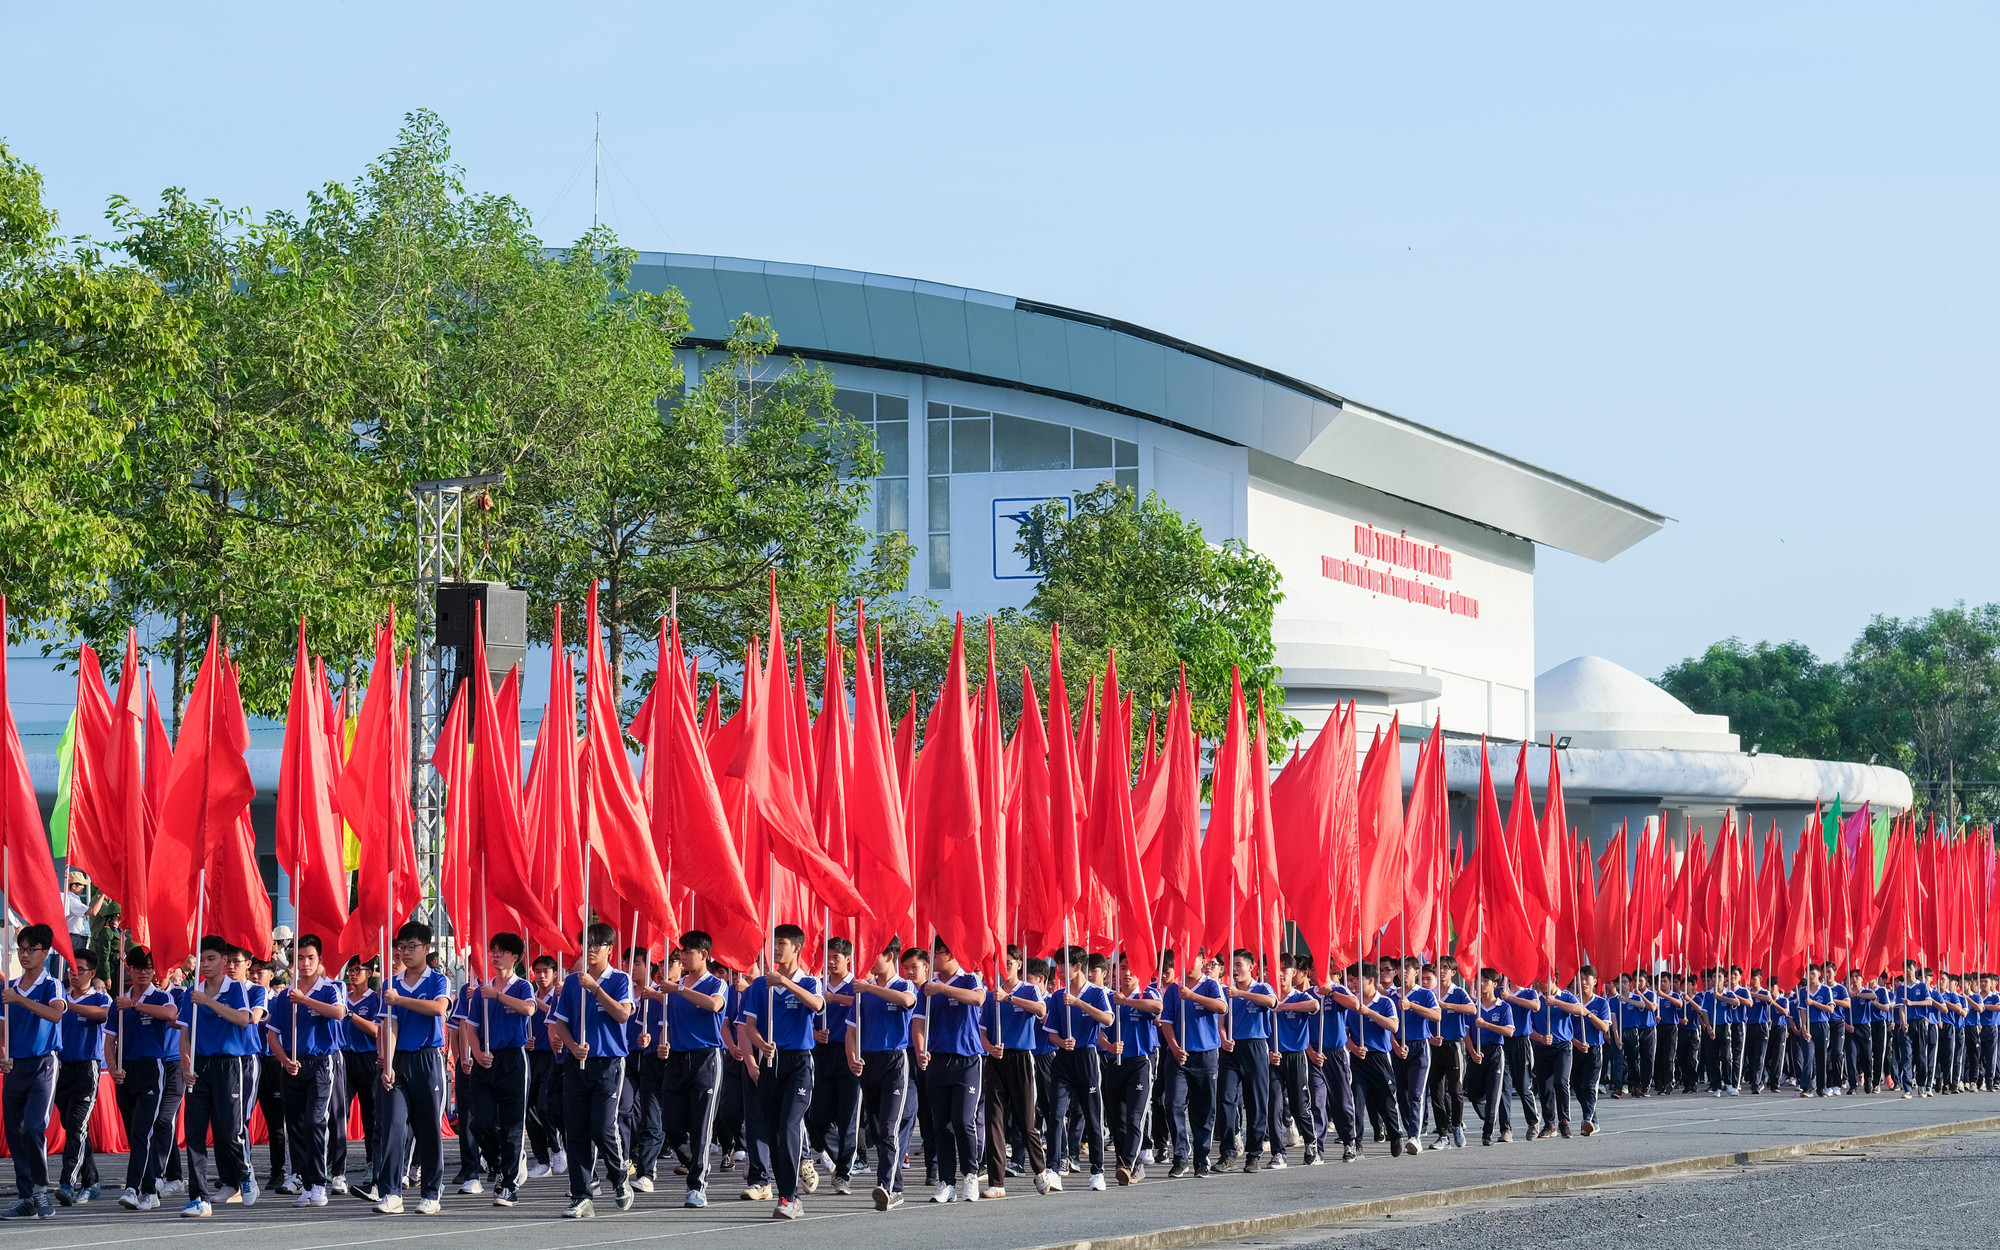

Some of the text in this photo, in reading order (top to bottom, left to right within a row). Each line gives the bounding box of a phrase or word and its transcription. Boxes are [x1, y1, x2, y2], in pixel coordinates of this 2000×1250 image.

[1354, 524, 1375, 558] NHÀ
[1375, 532, 1393, 564] THI
[1321, 555, 1342, 581] TRUNG
[1342, 558, 1356, 586] TÂM
[1368, 568, 1380, 599] DỤC
